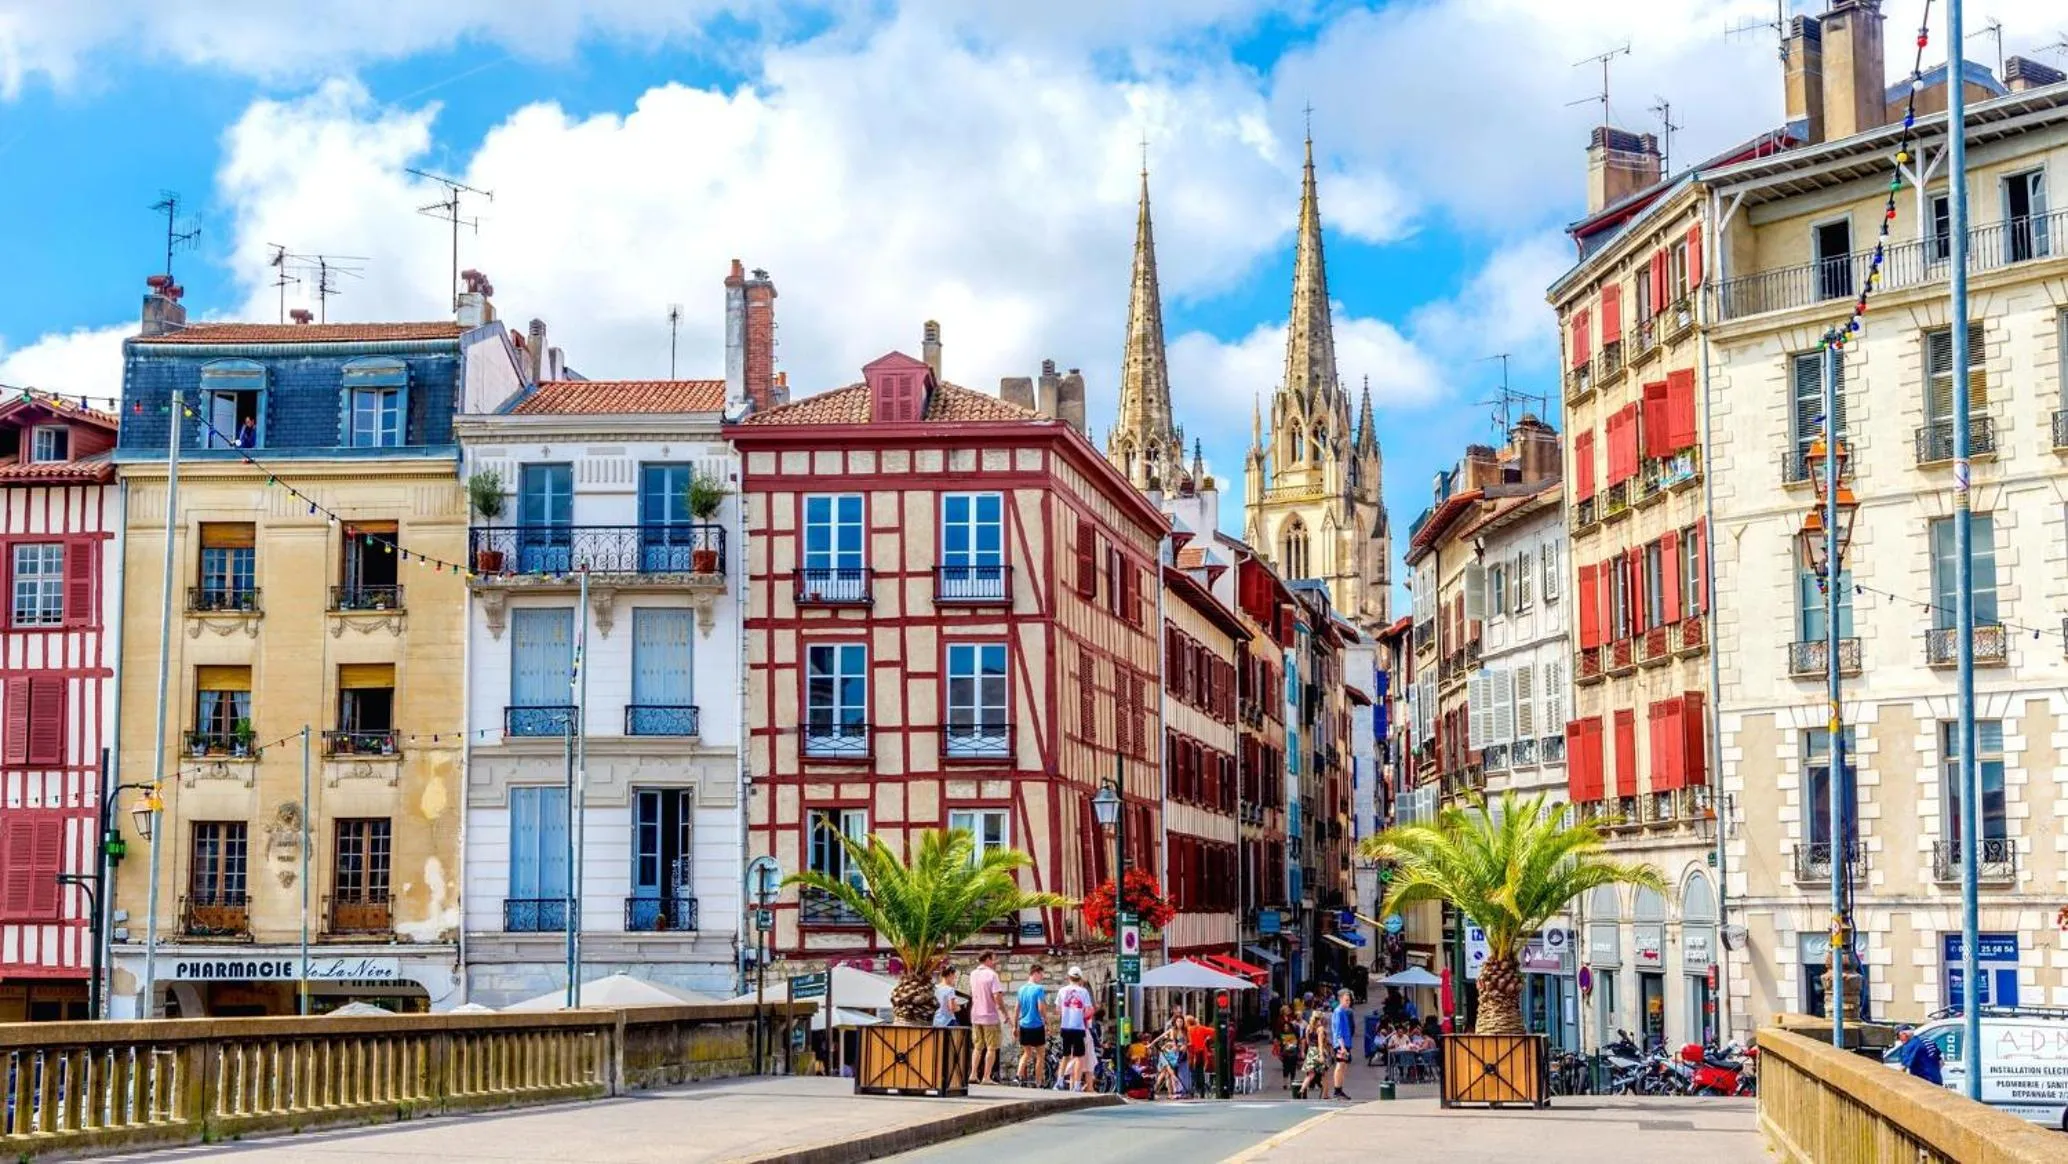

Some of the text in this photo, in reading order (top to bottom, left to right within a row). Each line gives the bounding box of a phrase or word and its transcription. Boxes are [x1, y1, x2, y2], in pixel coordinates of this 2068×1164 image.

[176, 961, 292, 978] PHARMACIE
[320, 959, 346, 977] La
[347, 958, 393, 977] Nive
[1990, 1066, 2041, 1074] INSTALLATION
[1996, 1080, 2039, 1088] PLOMBERIE
[2012, 1090, 2056, 1099] DEPANNAGE
